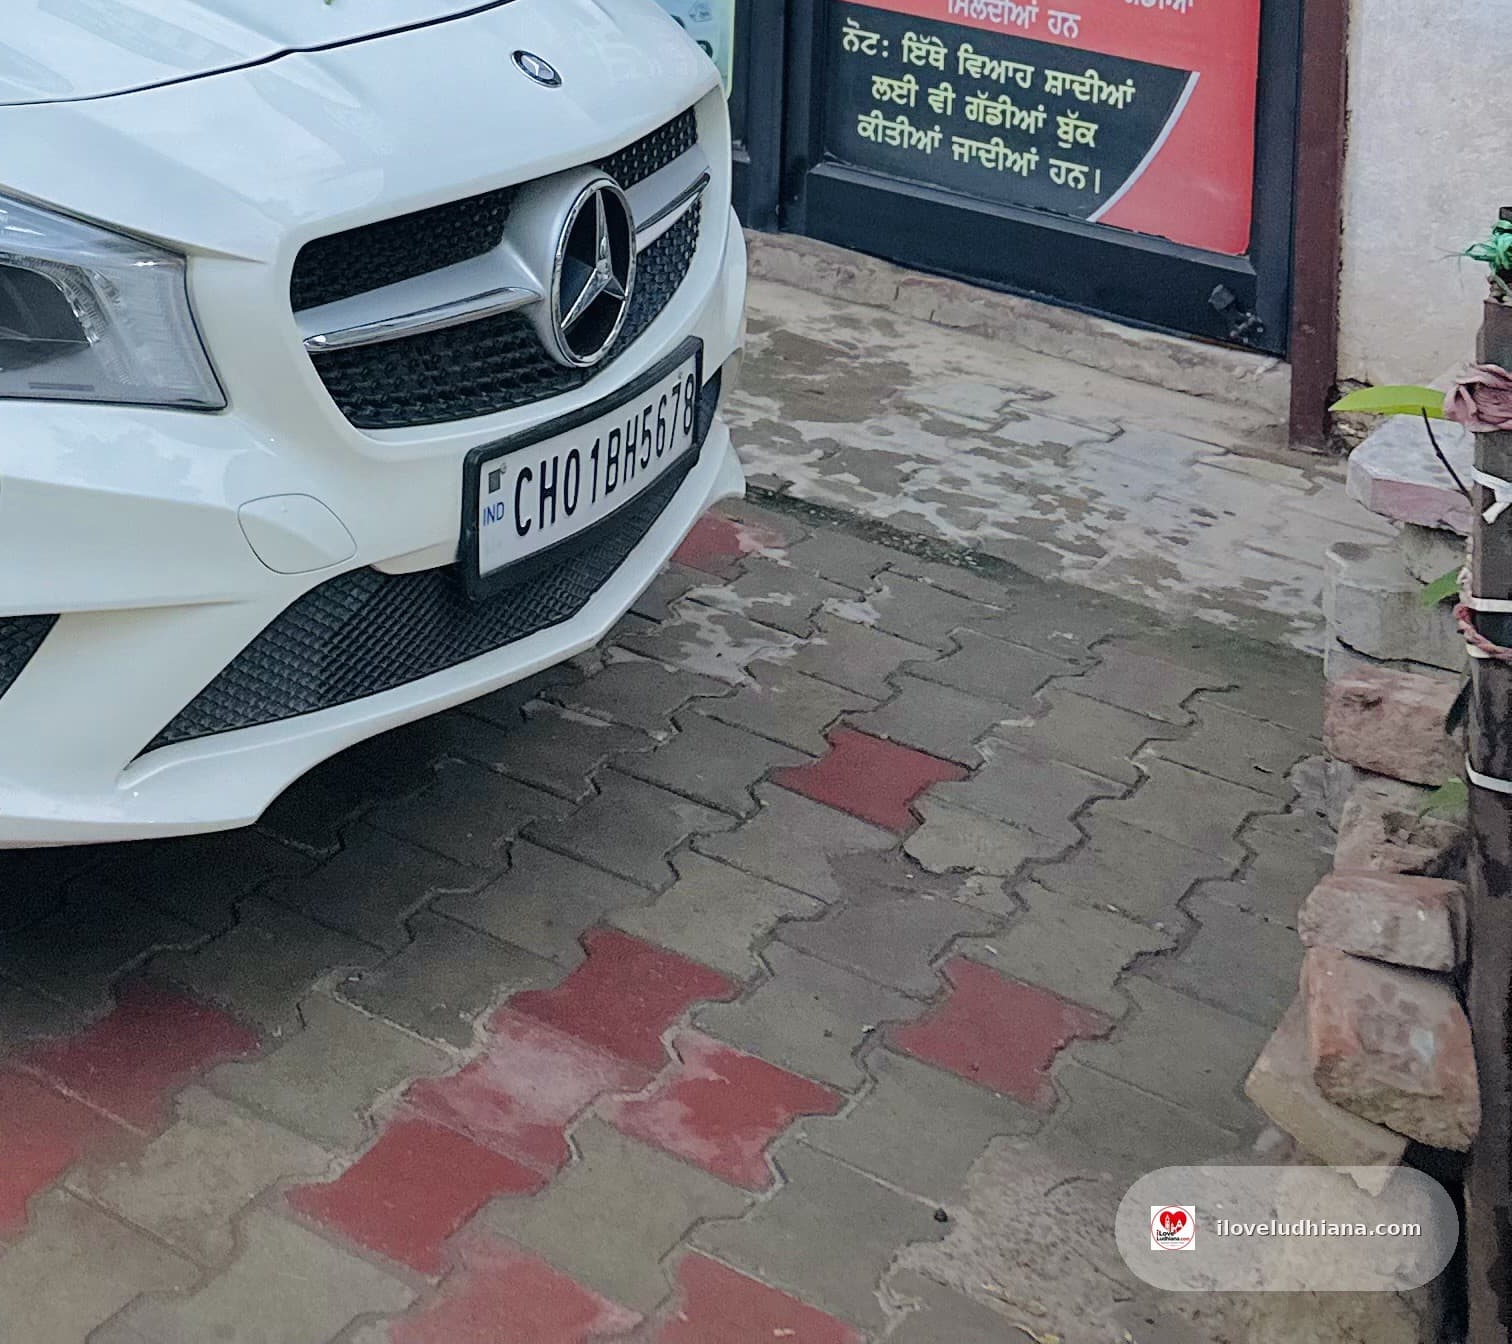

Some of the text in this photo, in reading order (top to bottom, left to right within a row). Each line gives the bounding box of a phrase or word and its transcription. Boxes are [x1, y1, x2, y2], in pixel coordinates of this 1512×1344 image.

[842, 17, 889, 58] ਨੋਟ:
[901, 31, 948, 71] ਇੱਥੇ
[957, 43, 1035, 88] ਵਿਆਹ
[1047, 9, 1081, 39] ਹਨ
[857, 109, 943, 154] ਕੀਤੀਆਂ
[871, 73, 1098, 149] ਲਈ ਵੀ ਗੱਡੀਆਂ ਬੁੱਕ
[514, 372, 695, 537] CH01BH5678
[482, 501, 505, 527] IND
